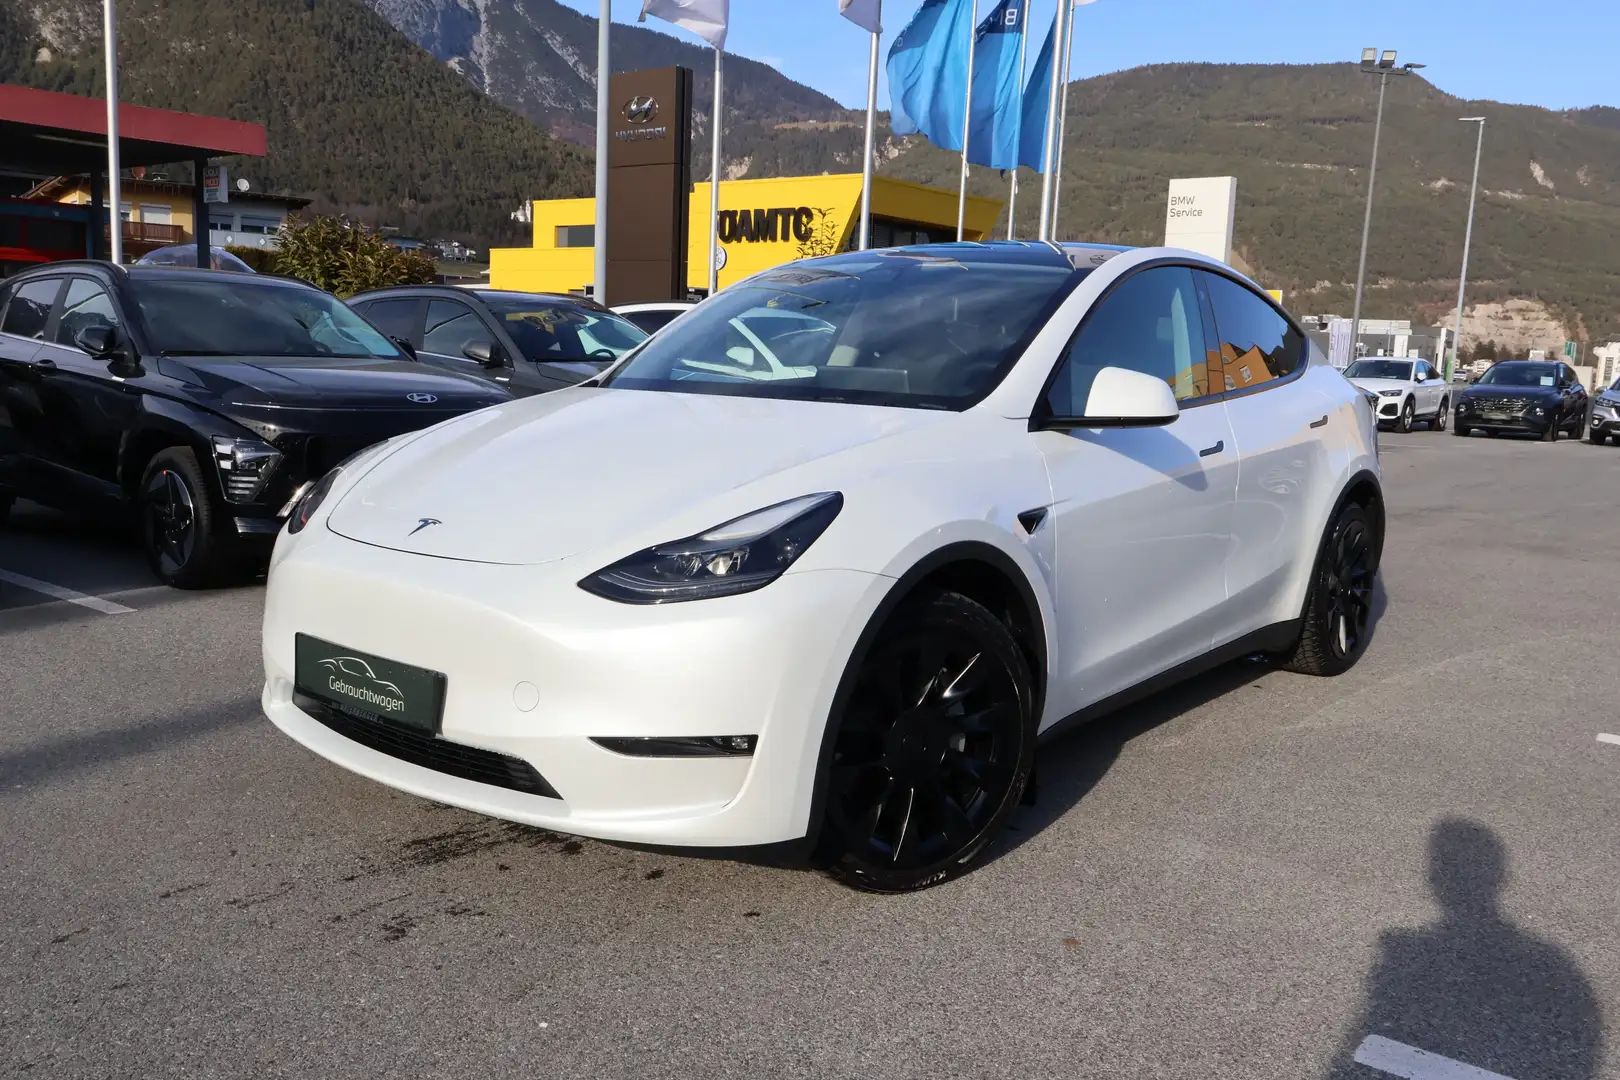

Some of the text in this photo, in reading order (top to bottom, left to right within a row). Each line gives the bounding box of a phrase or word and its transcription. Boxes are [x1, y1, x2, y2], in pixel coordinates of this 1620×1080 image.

[1170, 196, 1195, 206] BMW
[1169, 208, 1203, 217] Service
[328, 675, 405, 712] Gebrauchtwagen
